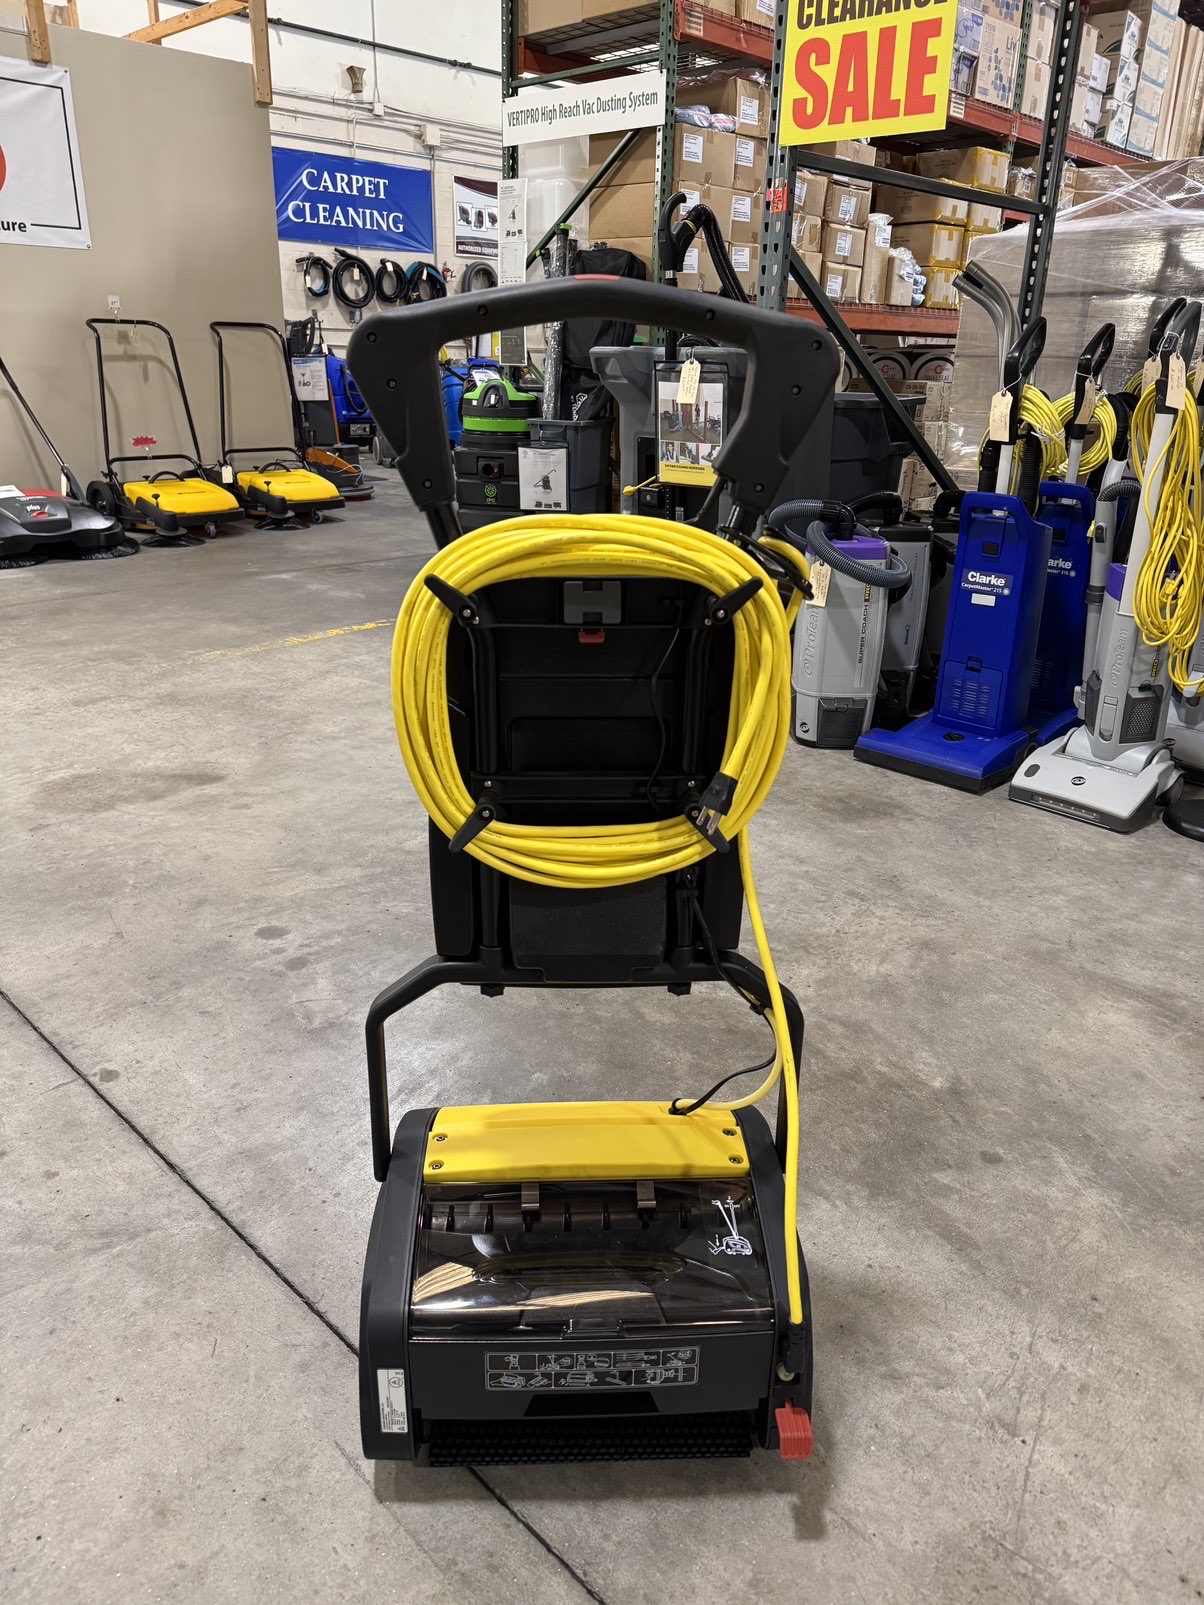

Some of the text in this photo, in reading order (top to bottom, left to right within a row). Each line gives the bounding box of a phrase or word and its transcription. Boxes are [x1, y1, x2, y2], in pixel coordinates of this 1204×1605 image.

[797, 0, 948, 30] CLEAR
[792, 17, 943, 130] SALE
[507, 91, 658, 127] VERTIPRO High Reach Vac Dusting System
[301, 168, 389, 200] CARPET
[0, 220, 27, 232] ure
[287, 201, 405, 233] CLEANING
[26, 504, 41, 512] plus
[1047, 558, 1072, 569] arke
[961, 581, 994, 592] CarpetMaster
[967, 571, 1006, 587] Clarke
[861, 604, 869, 634] COACH
[1112, 628, 1129, 674] ProTeam
